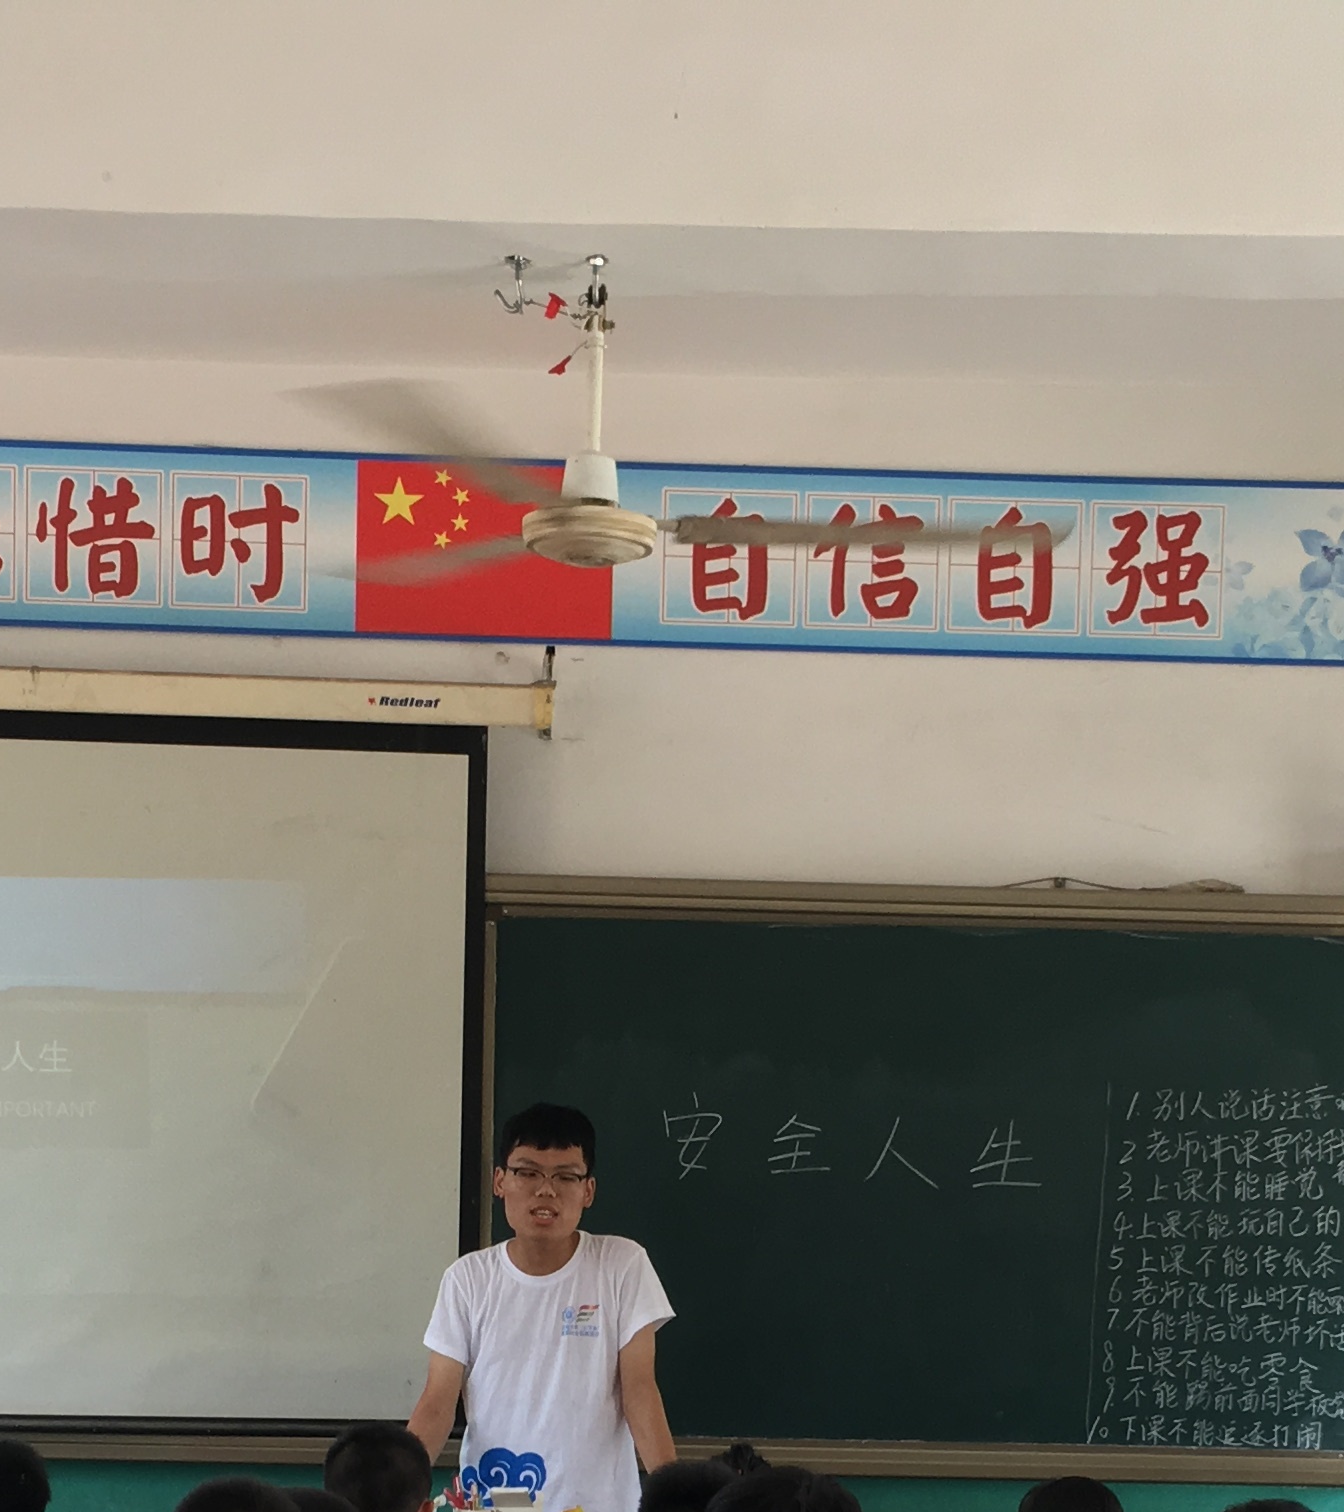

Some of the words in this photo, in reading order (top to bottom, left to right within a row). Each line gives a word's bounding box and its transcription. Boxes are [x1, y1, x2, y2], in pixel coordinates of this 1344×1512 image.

[692, 498, 1210, 629] 自信自强
[379, 696, 441, 709] Redleaf
[663, 1091, 1043, 1190] 安全人生
